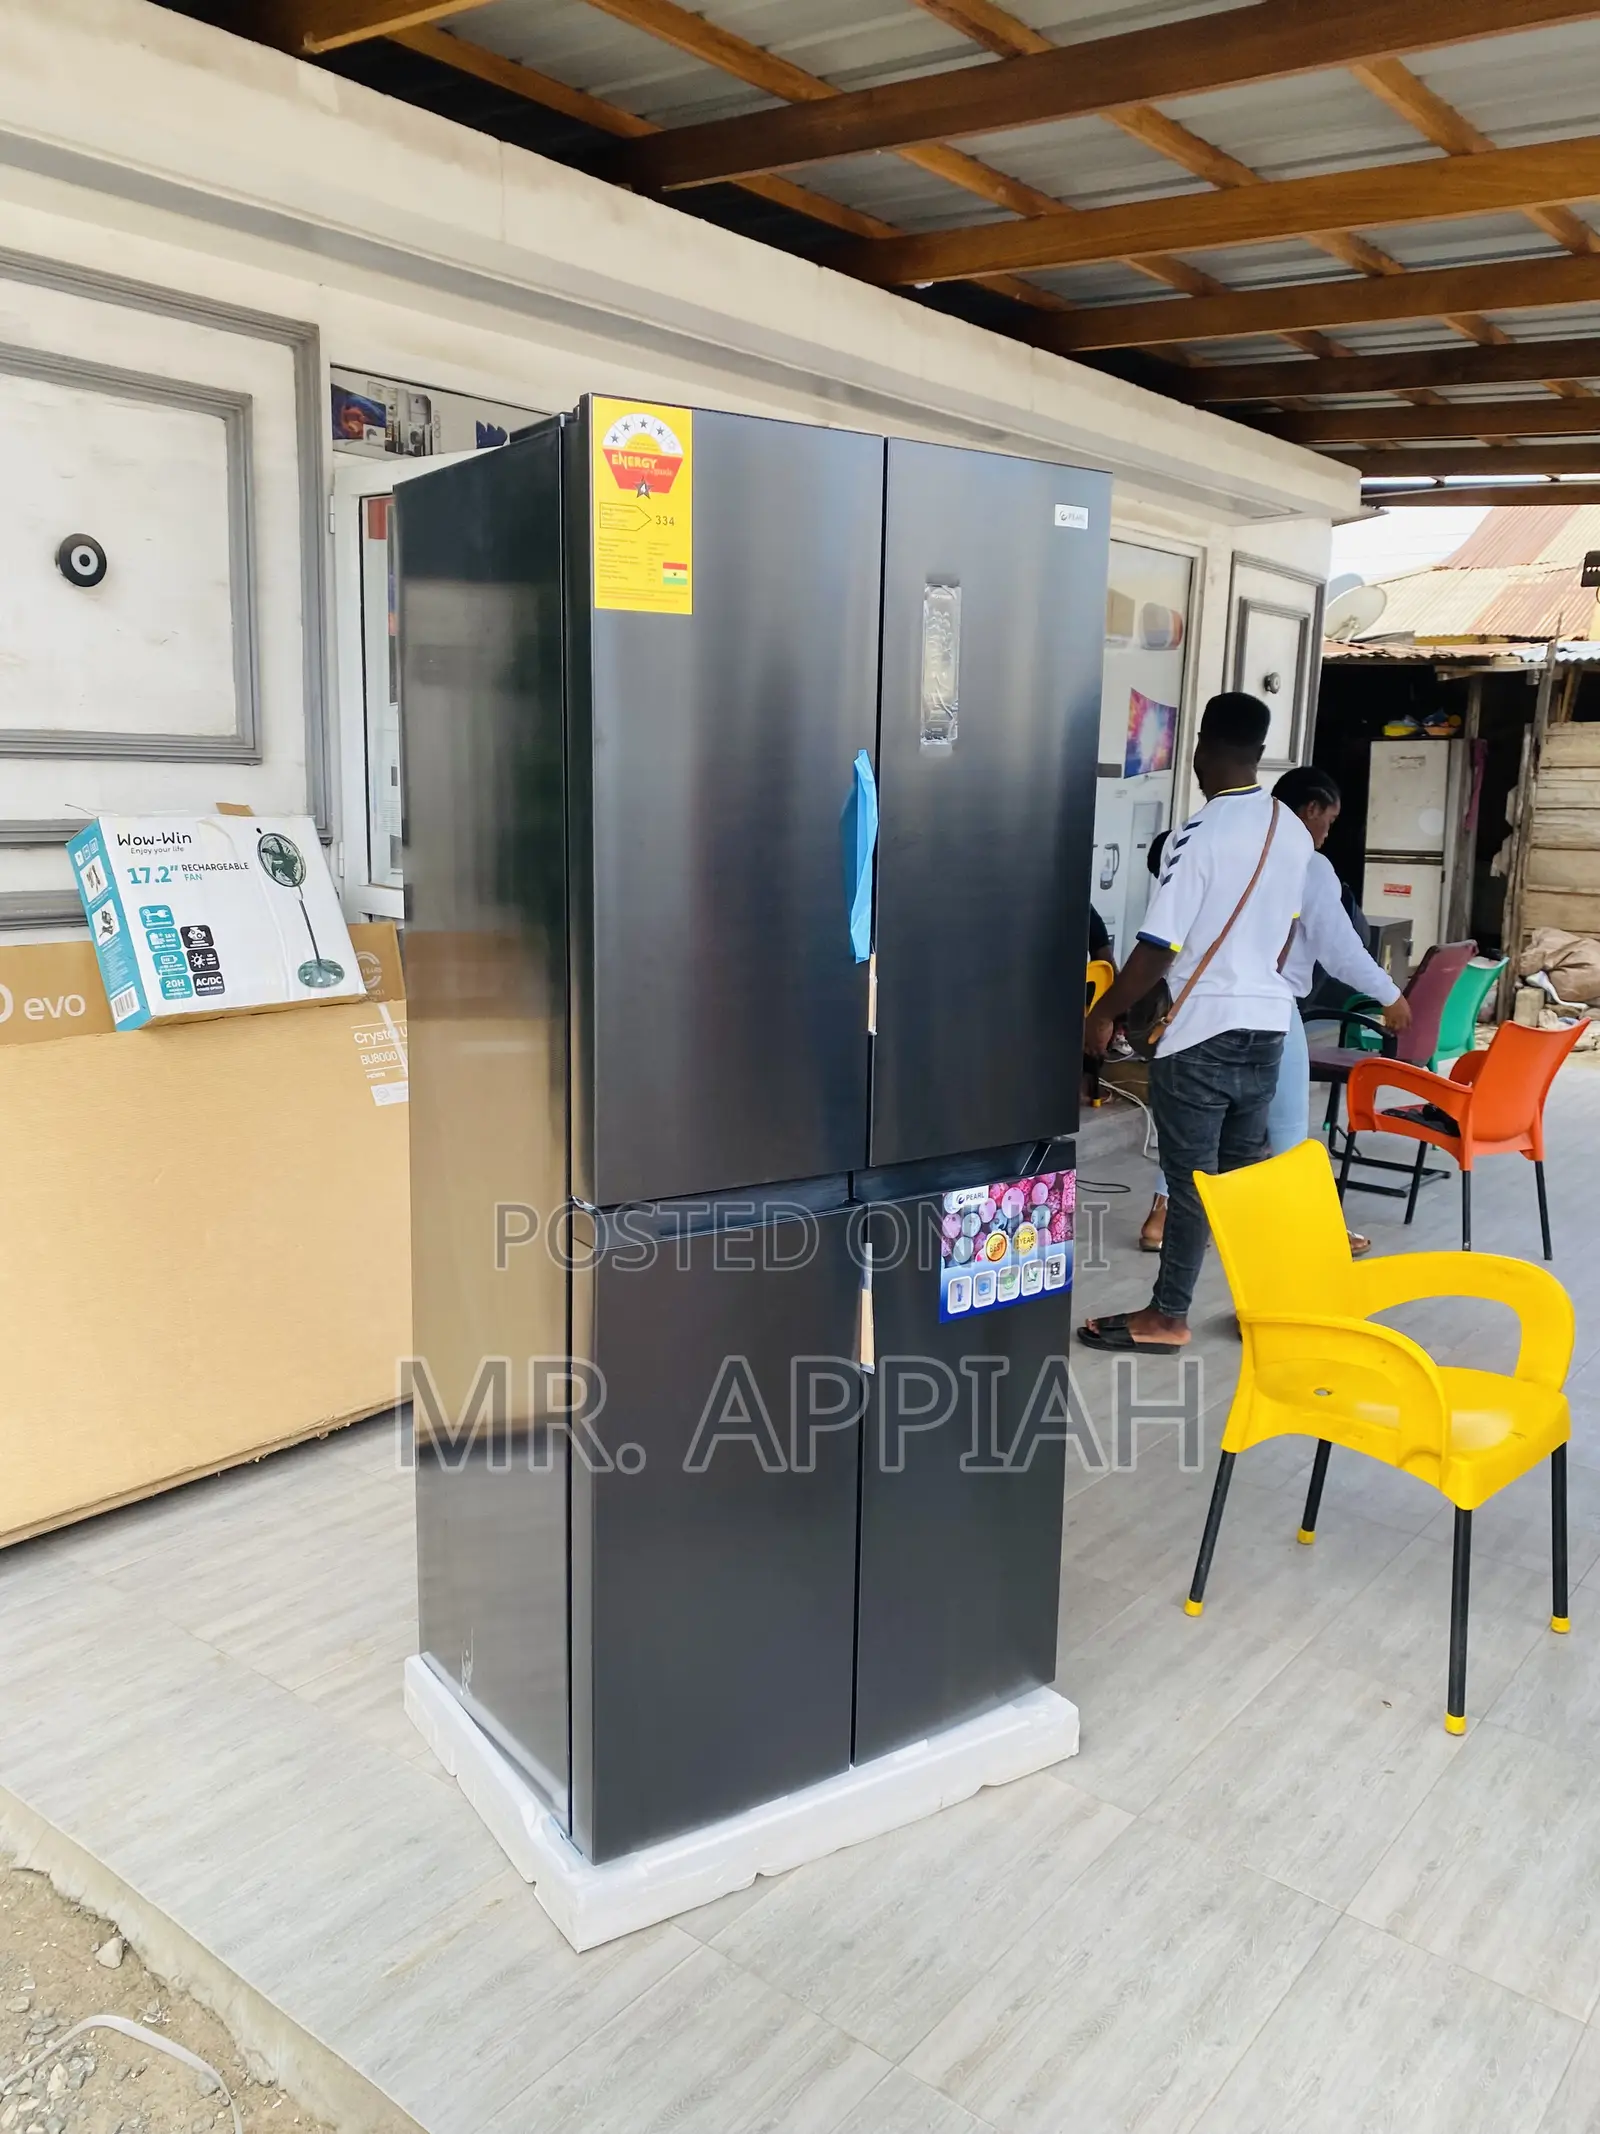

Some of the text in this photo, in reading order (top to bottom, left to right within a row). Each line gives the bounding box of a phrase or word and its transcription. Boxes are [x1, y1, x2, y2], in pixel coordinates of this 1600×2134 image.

[611, 451, 658, 470] ENERGY
[655, 515, 675, 526] 334
[117, 832, 192, 846] Wow-Win
[131, 847, 152, 855] Enjoy
[127, 862, 250, 884] 17.2" RECHARGEABLE
[184, 873, 203, 881] FAN
[165, 979, 185, 988] 20H
[196, 976, 222, 987] AC/DC
[24, 994, 86, 1020] evo
[354, 1026, 399, 1045] Cryst
[360, 1051, 398, 1065] BU8000
[966, 1192, 985, 1201] PEARL
[1020, 1235, 1035, 1244] YEAR
[990, 1240, 1005, 1253] BEST
